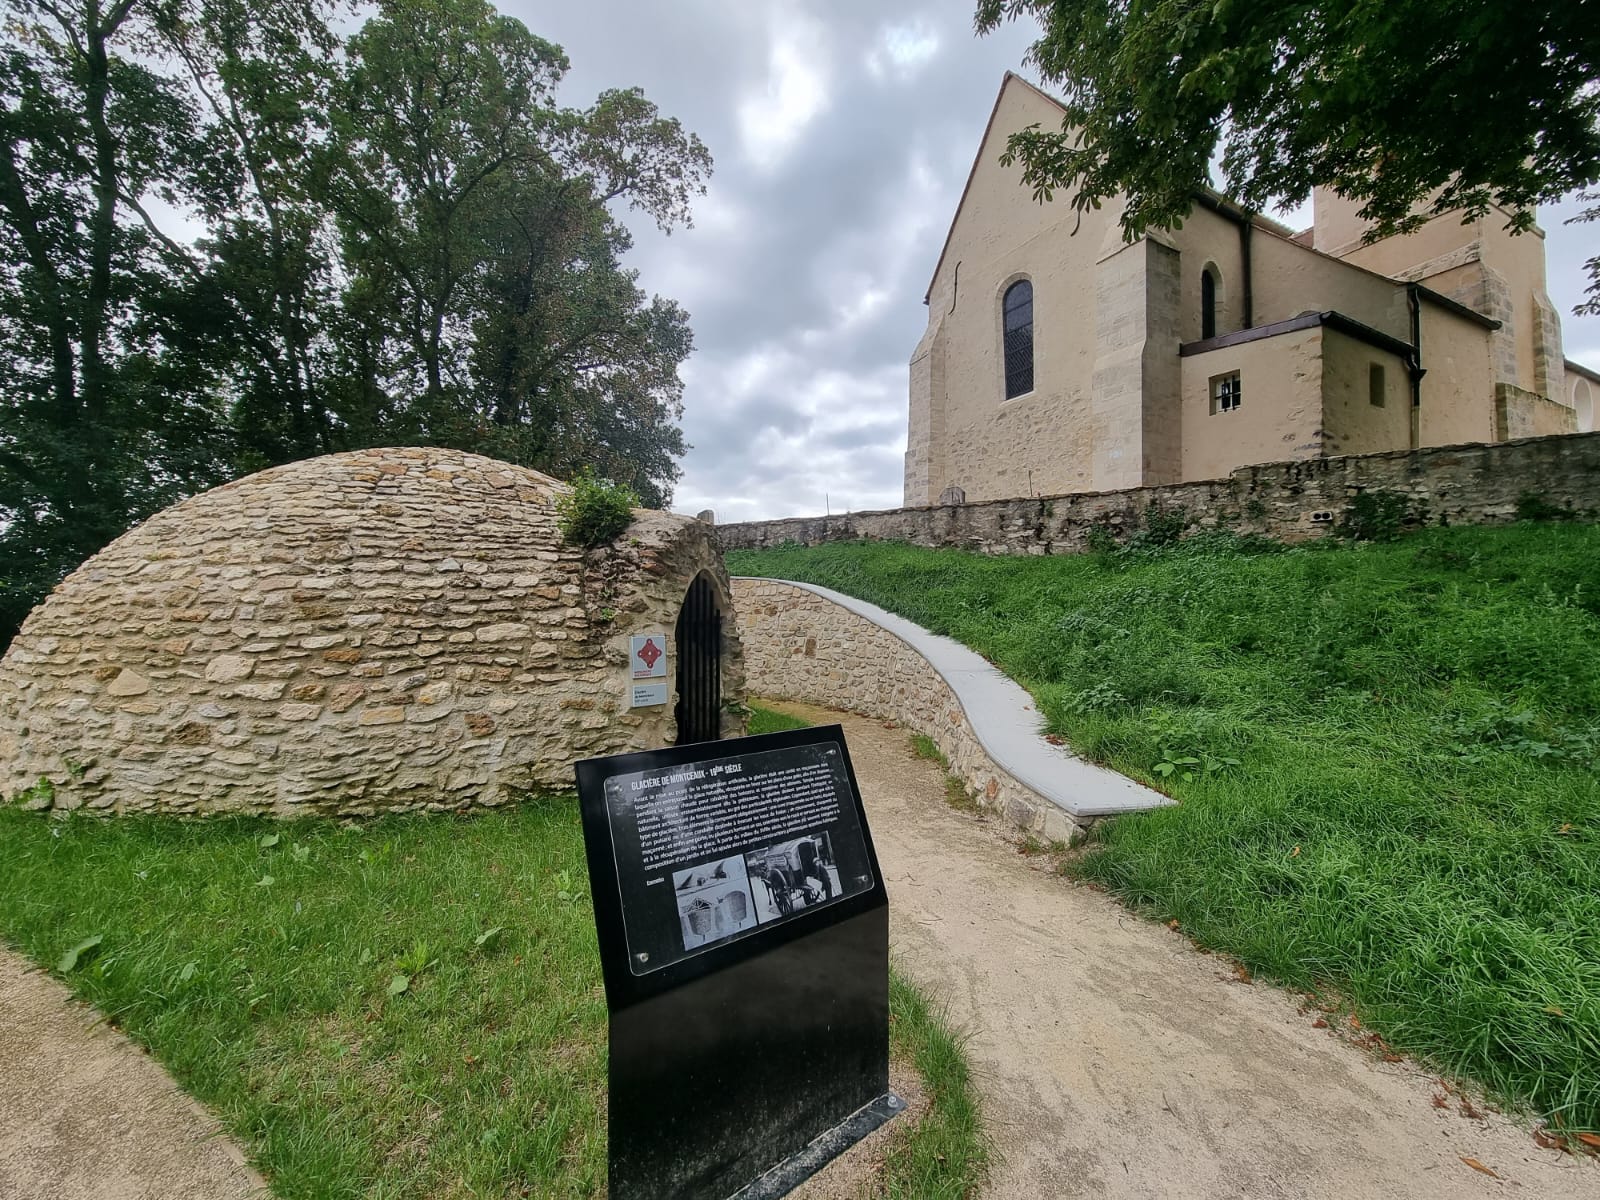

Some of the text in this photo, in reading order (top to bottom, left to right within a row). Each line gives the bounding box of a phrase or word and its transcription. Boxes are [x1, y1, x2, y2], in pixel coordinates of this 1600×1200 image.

[631, 777, 661, 791] GLACIÈRE
[661, 776, 671, 786] DE
[670, 770, 706, 784] MONTCEAUX
[725, 763, 742, 774] SIÈCLE
[636, 808, 657, 818] pendant
[639, 832, 652, 841] type
[644, 858, 675, 872] composition
